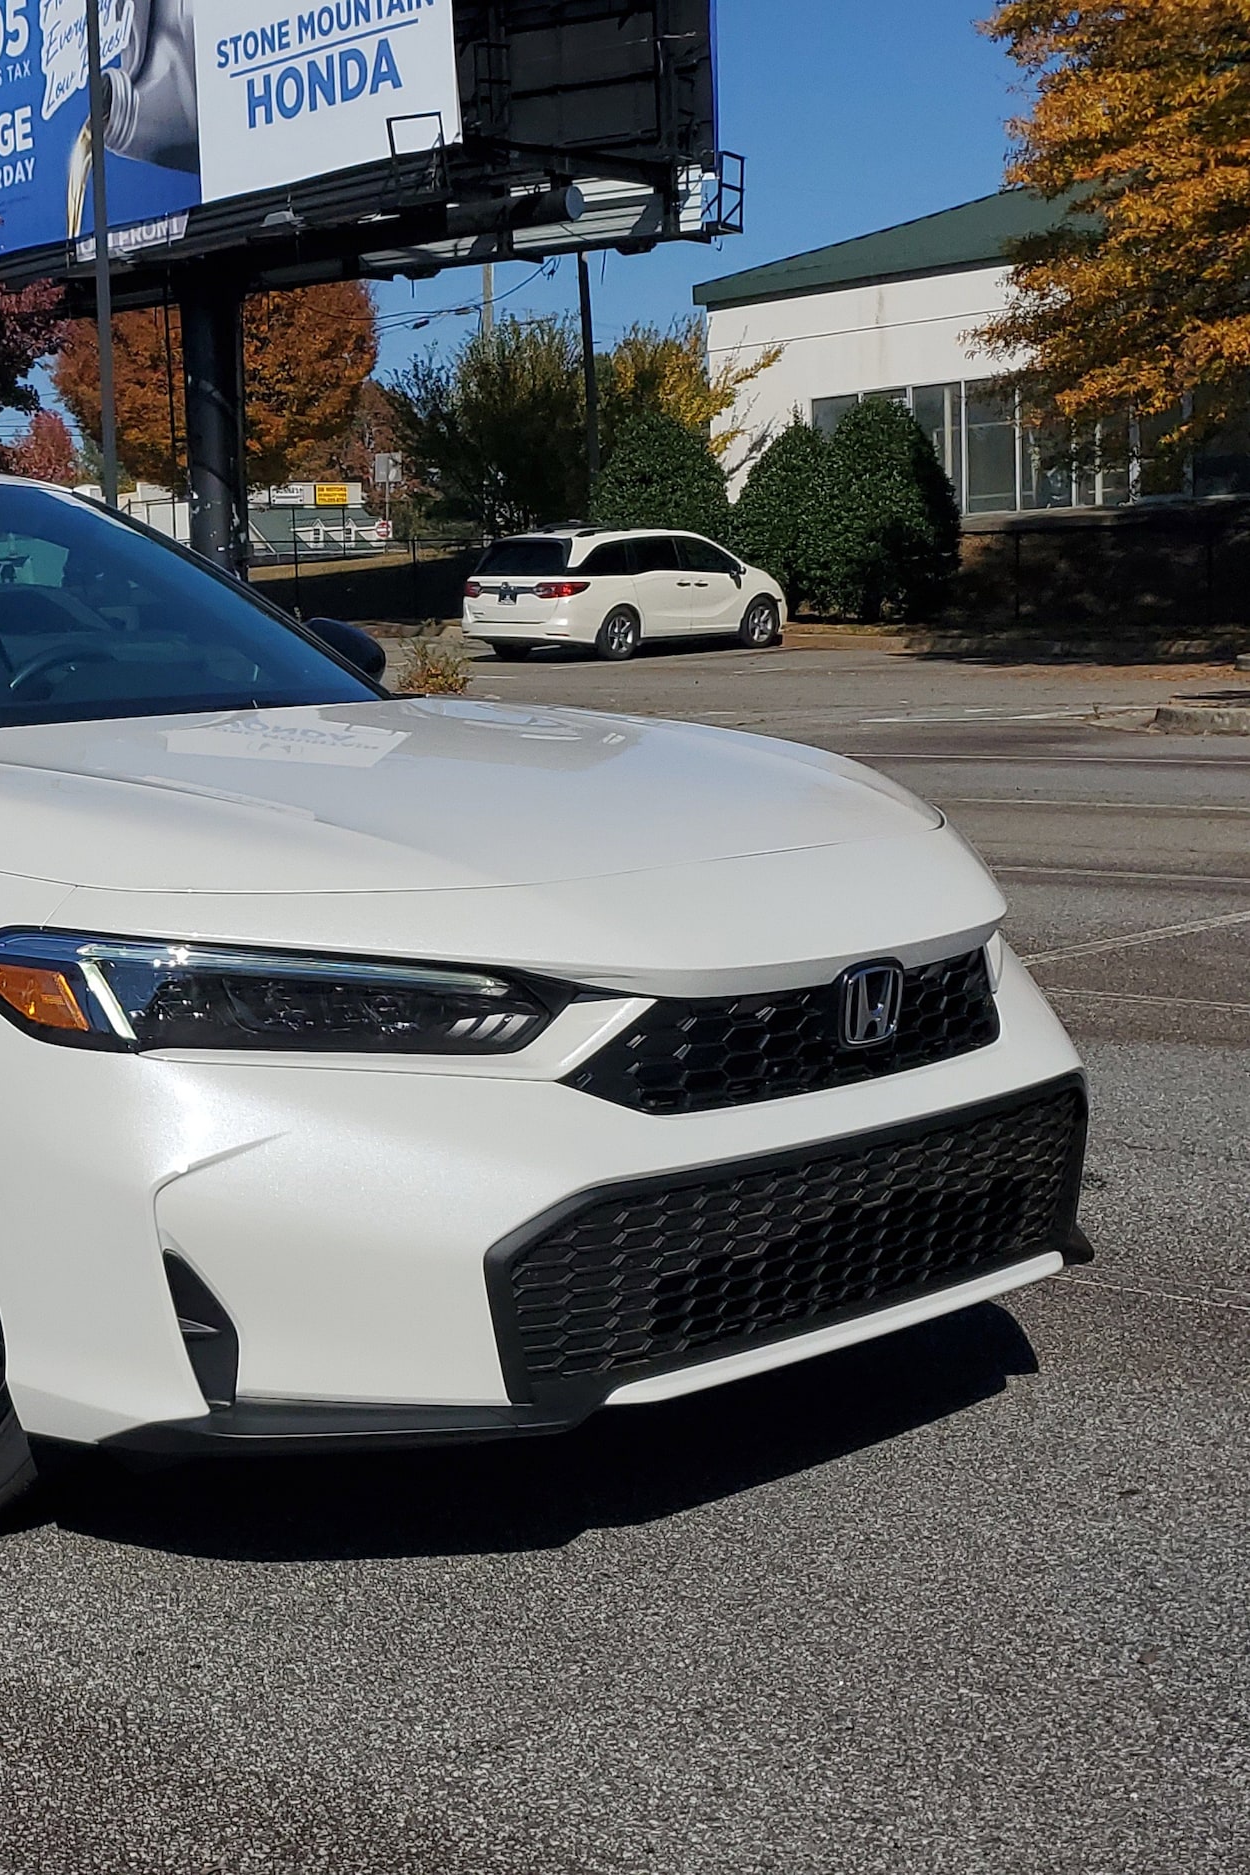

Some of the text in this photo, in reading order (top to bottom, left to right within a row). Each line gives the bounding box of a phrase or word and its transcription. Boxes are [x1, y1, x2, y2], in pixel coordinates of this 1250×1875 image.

[216, 18, 291, 69] STONE
[7, 60, 30, 83] TAX
[247, 38, 403, 129] HONDA
